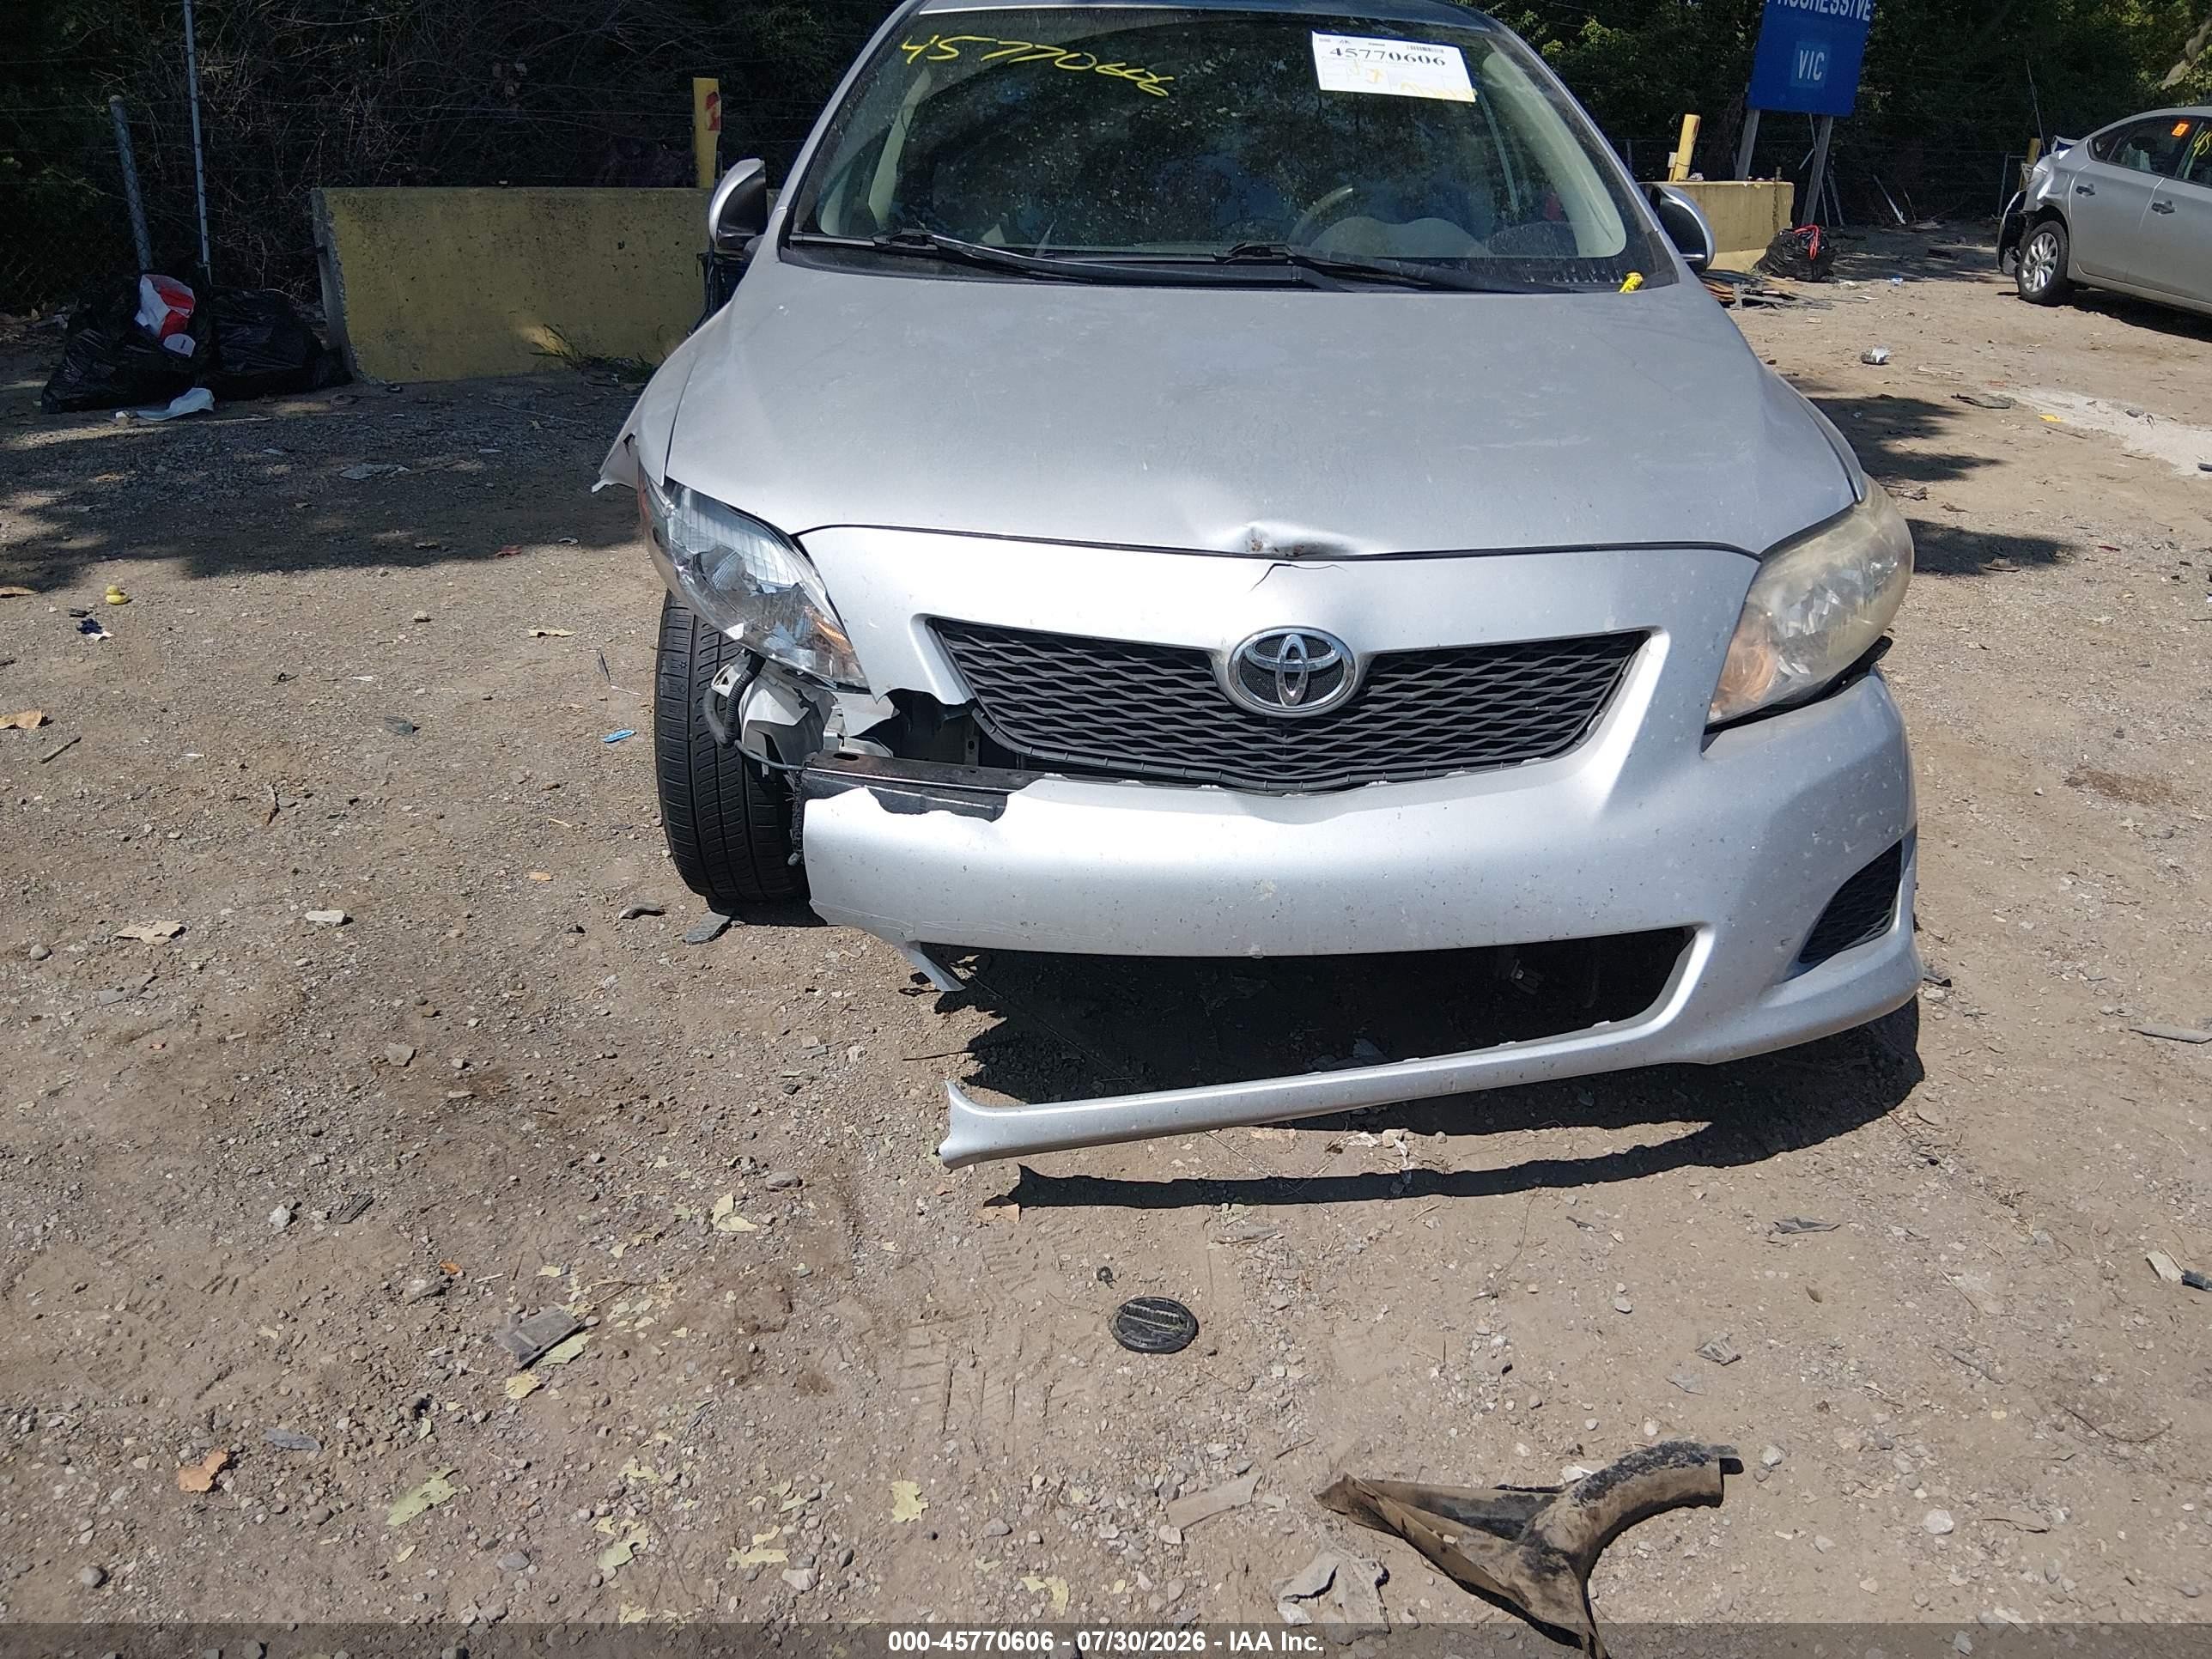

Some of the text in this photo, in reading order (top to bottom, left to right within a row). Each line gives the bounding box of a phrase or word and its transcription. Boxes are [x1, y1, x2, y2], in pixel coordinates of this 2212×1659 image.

[1766, 0, 1871, 21] ESSIVE
[1329, 47, 1446, 67] 45770606
[1798, 49, 1825, 81] VIC
